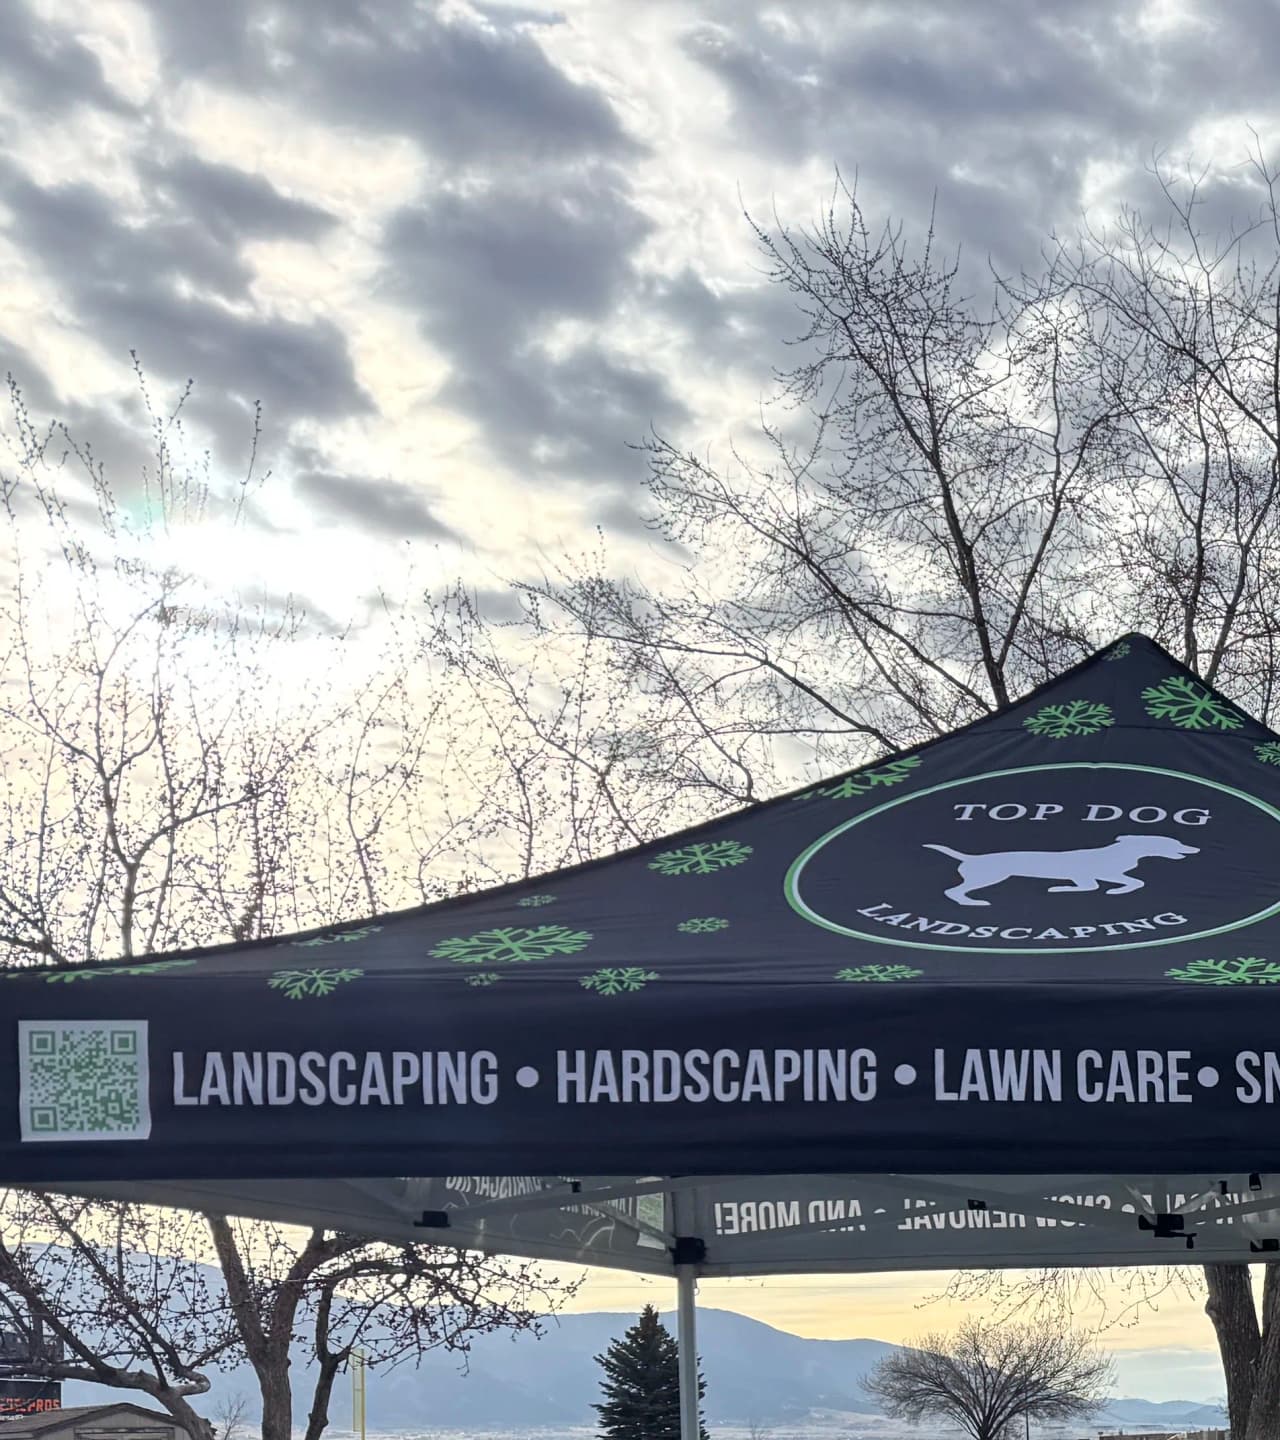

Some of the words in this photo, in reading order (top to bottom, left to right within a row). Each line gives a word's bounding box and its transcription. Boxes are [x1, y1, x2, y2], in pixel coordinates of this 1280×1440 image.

[954, 803, 1064, 821] TOP
[1081, 804, 1212, 826] DOG
[857, 902, 1189, 940] LANDSCAPING
[172, 1050, 498, 1106] LANDSCAPING
[557, 1048, 877, 1104] HARDSCAPING
[934, 1048, 1062, 1102] LAWN
[1076, 1049, 1192, 1103] CARE
